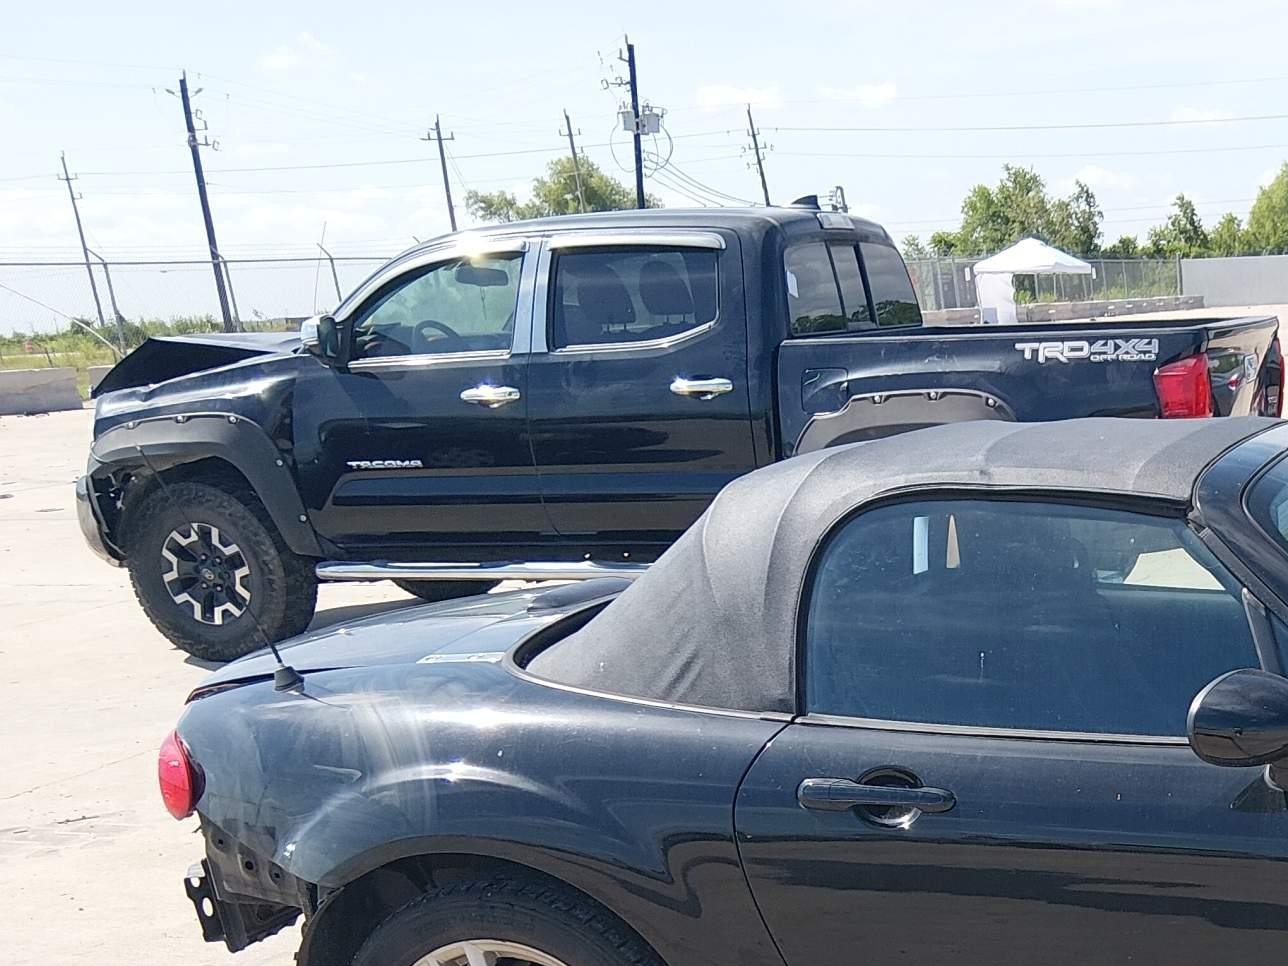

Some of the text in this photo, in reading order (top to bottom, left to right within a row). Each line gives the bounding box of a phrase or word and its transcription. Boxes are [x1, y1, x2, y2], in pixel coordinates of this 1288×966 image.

[1015, 339, 1159, 363] TRD 4X4
[346, 460, 424, 469] TACOMA
